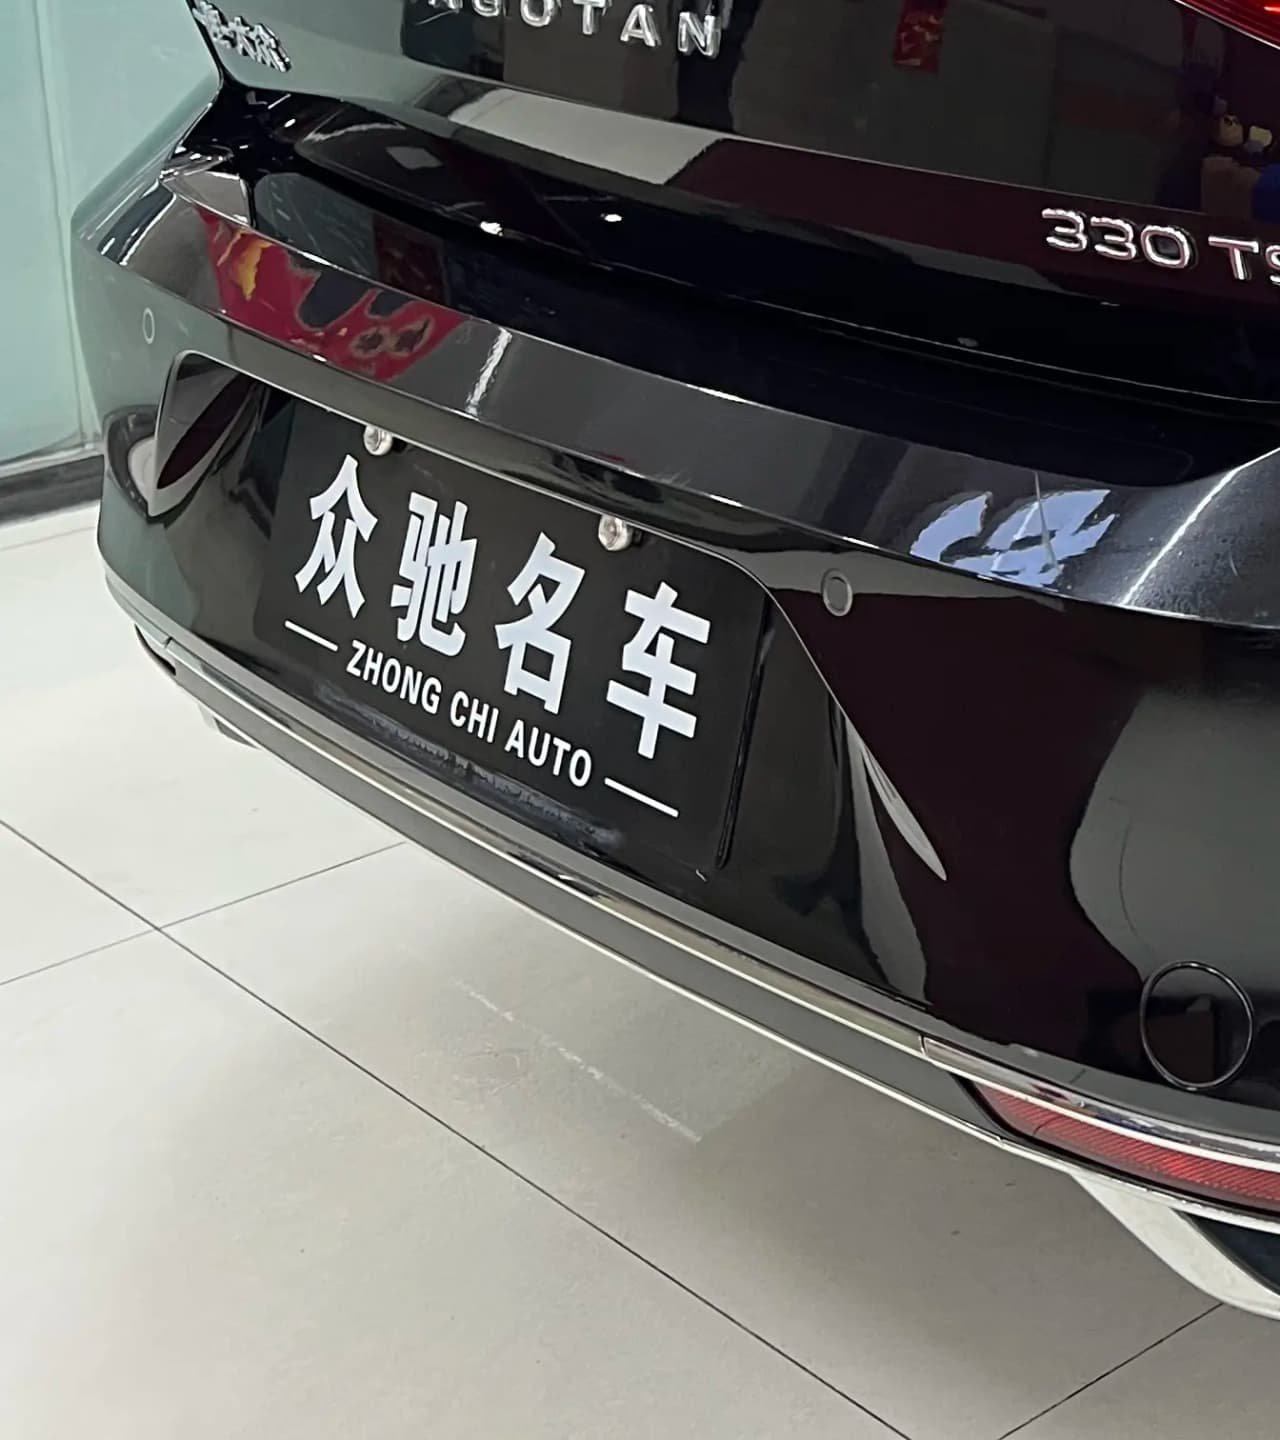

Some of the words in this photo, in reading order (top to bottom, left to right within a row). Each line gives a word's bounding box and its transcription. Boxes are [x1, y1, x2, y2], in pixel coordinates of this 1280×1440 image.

[1040, 207, 1192, 271] 330
[293, 454, 713, 761] 众驰名车
[346, 640, 443, 716] ZHONG
[449, 690, 499, 743] CHI
[505, 718, 594, 788] AUTO
